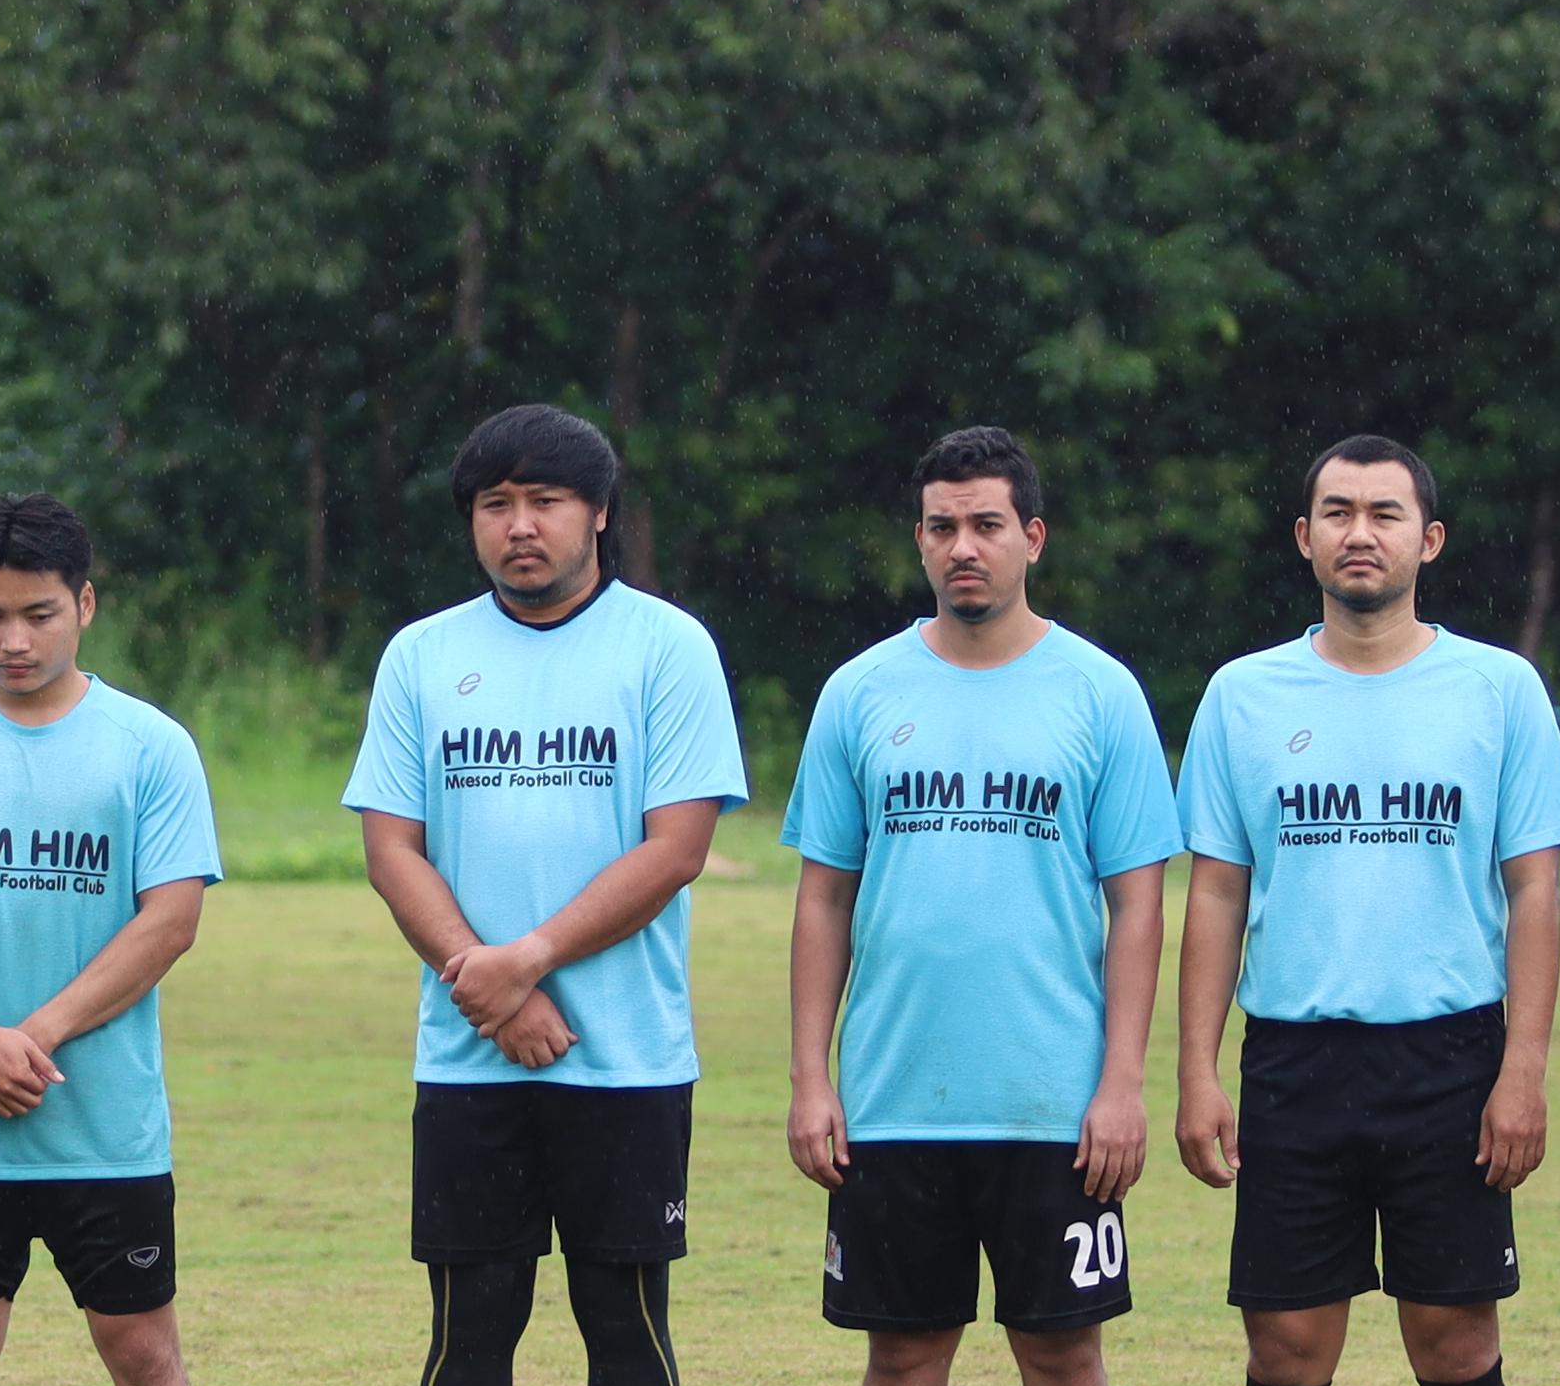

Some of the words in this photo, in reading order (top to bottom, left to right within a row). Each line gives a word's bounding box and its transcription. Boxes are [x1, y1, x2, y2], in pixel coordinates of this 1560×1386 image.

[442, 727, 521, 765] HIM
[538, 726, 617, 765] HIM
[510, 771, 572, 787] Football
[579, 771, 613, 787] Club
[884, 771, 964, 811] HIM
[983, 771, 1062, 816] HIM
[1277, 783, 1361, 821] HIM
[1382, 782, 1461, 824] HIM
[885, 816, 943, 835] Maesod
[951, 817, 1017, 835] Football
[1025, 822, 1060, 841] Club
[1278, 828, 1342, 847] Maesod
[1350, 828, 1419, 844] Football
[31, 829, 109, 872] HIM
[0, 873, 66, 892] Football
[73, 878, 105, 895] Club
[1064, 1211, 1124, 1288] 20
